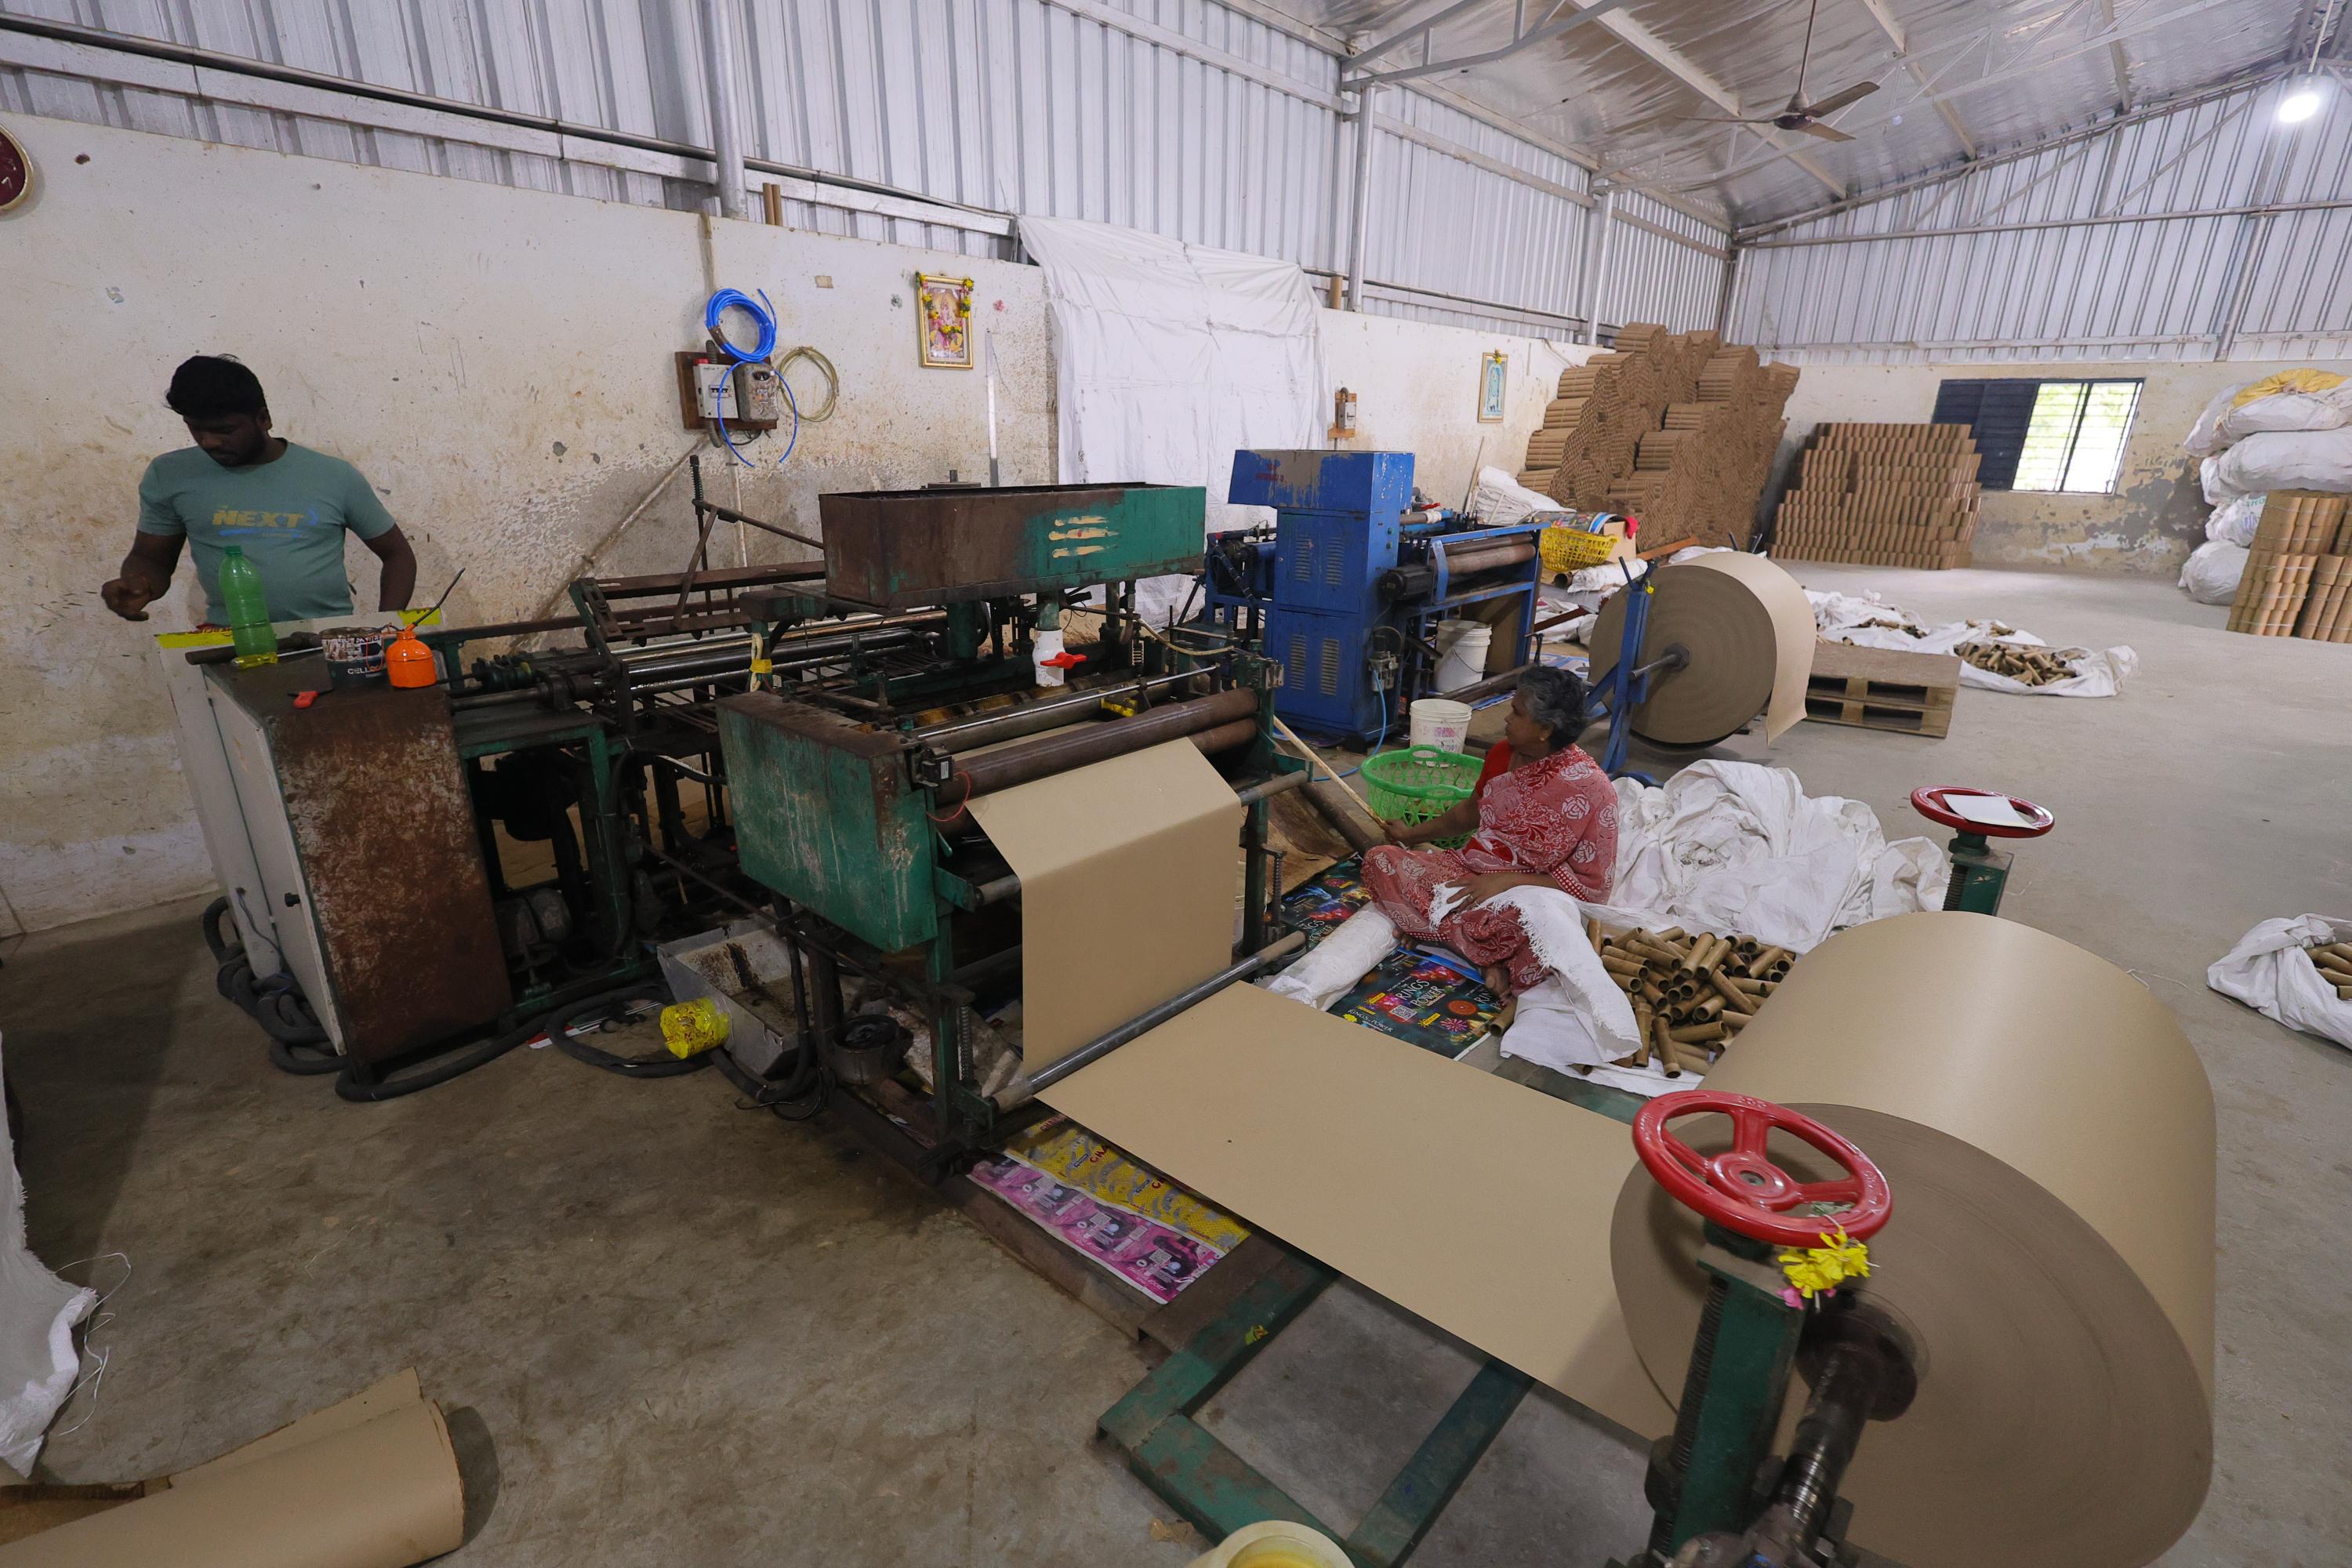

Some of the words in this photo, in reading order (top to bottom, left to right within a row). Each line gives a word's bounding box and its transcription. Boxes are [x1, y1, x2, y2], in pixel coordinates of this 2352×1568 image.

[212, 509, 305, 528] NEXT
[1396, 978, 1430, 1000] RINGS
[1410, 985, 1446, 1007] POWER
